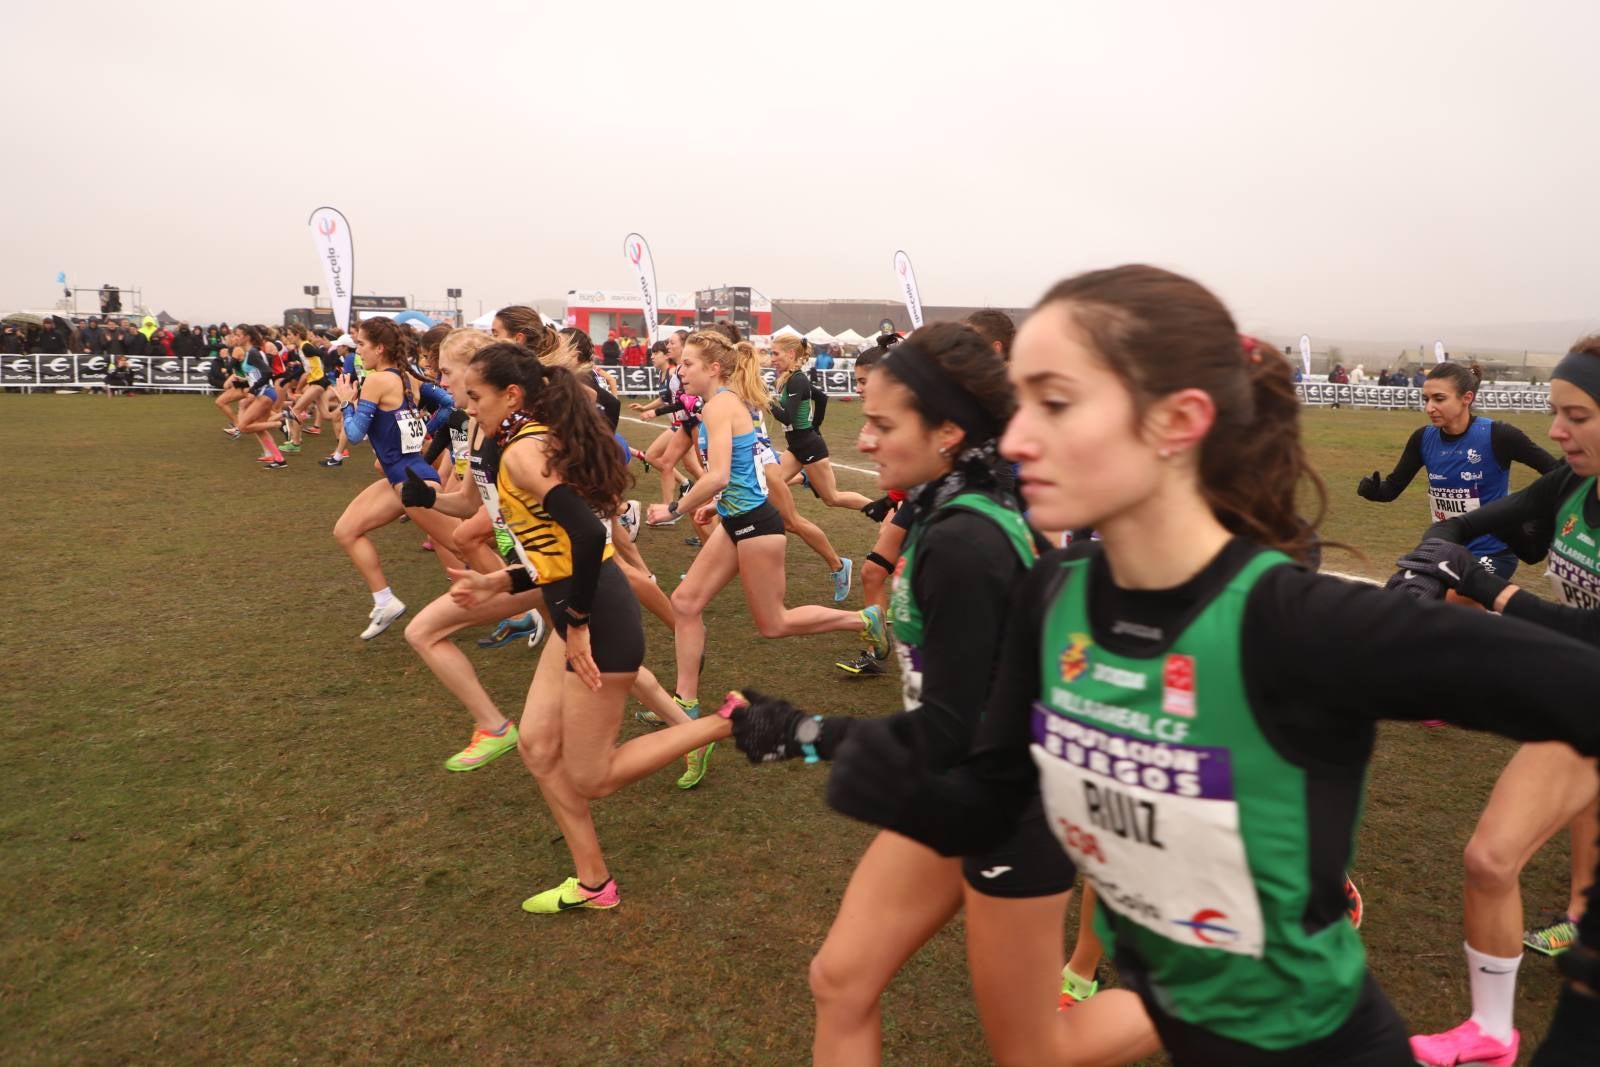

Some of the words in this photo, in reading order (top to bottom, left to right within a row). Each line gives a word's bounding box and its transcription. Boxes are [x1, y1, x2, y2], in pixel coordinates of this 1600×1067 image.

[408, 420, 424, 439] 329
[1436, 498, 1467, 513] FRAILE
[1081, 777, 1166, 852] RUIZ
